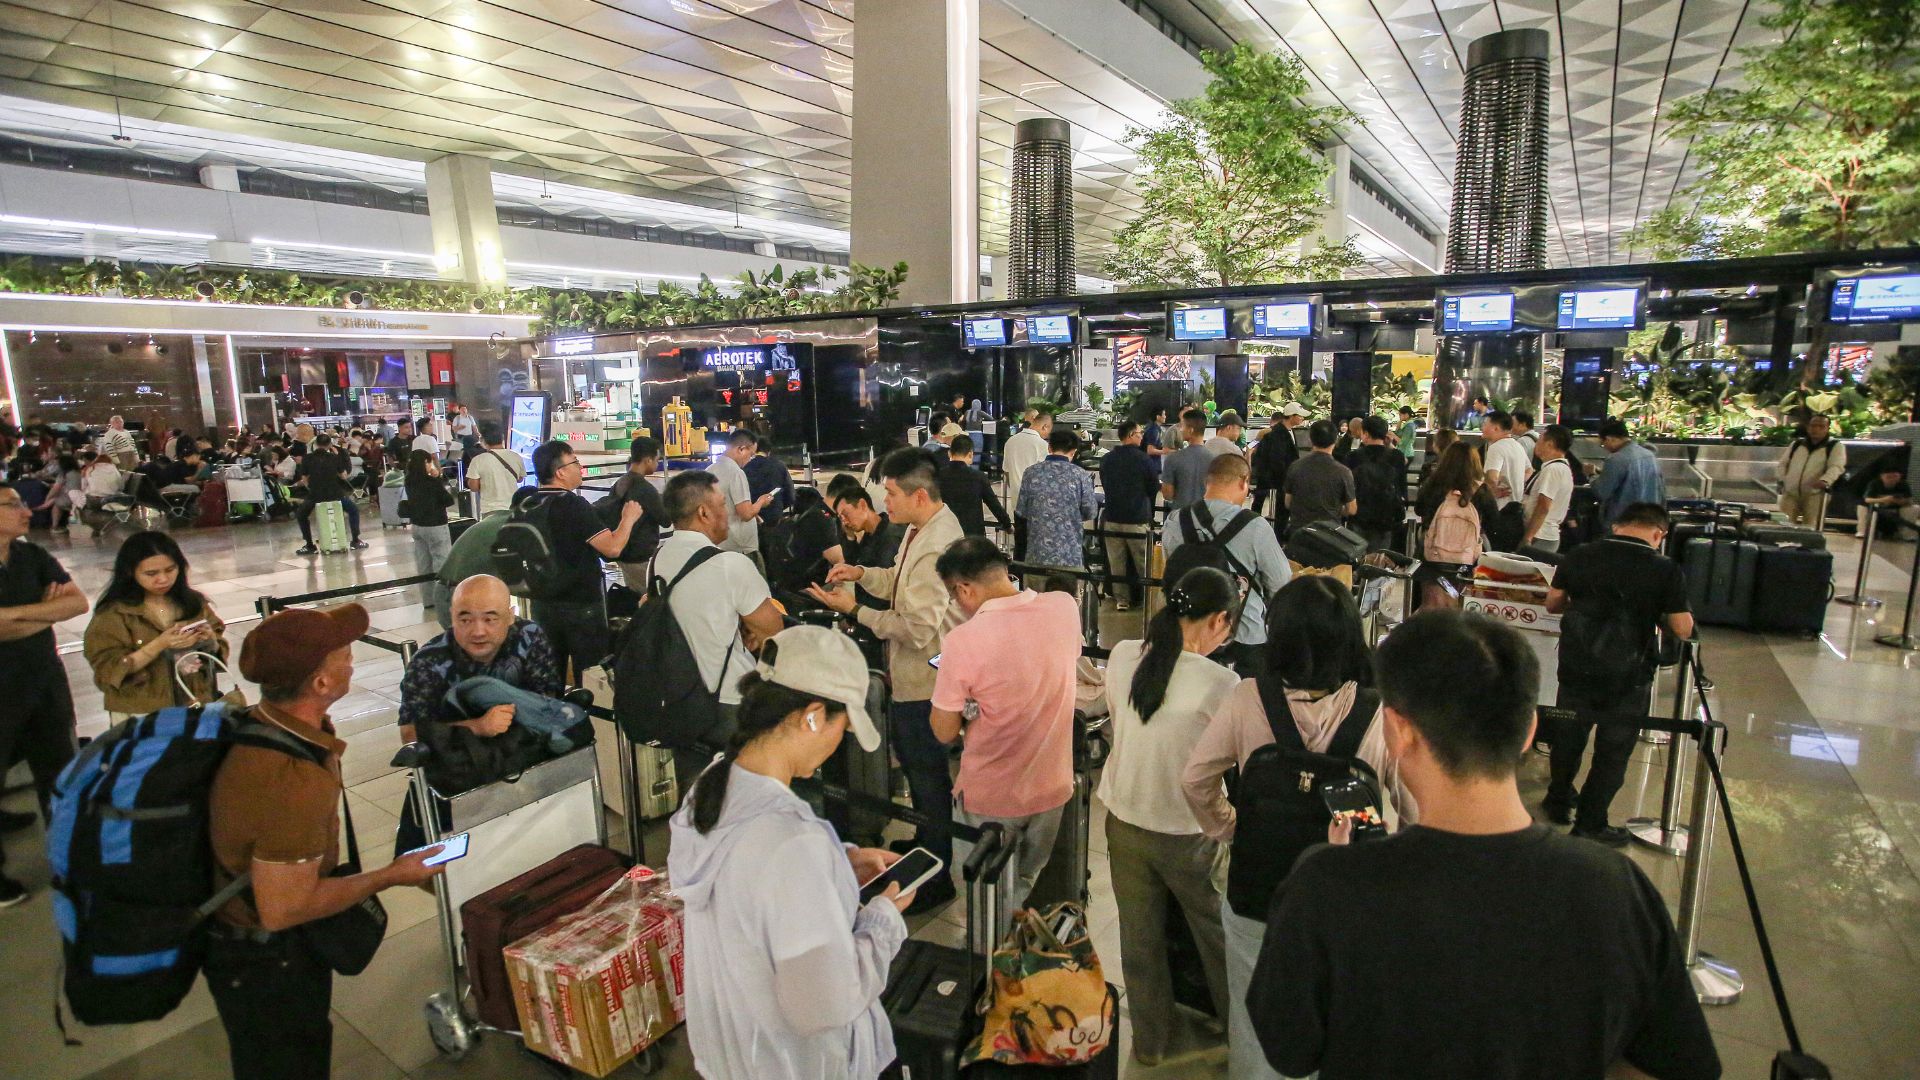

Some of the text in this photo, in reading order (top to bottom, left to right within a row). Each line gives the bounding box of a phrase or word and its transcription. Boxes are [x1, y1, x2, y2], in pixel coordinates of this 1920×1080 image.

[706, 351, 763, 365] AEROTEK
[619, 950, 635, 986] RAGILE
[600, 971, 616, 1015] FRAGILE
